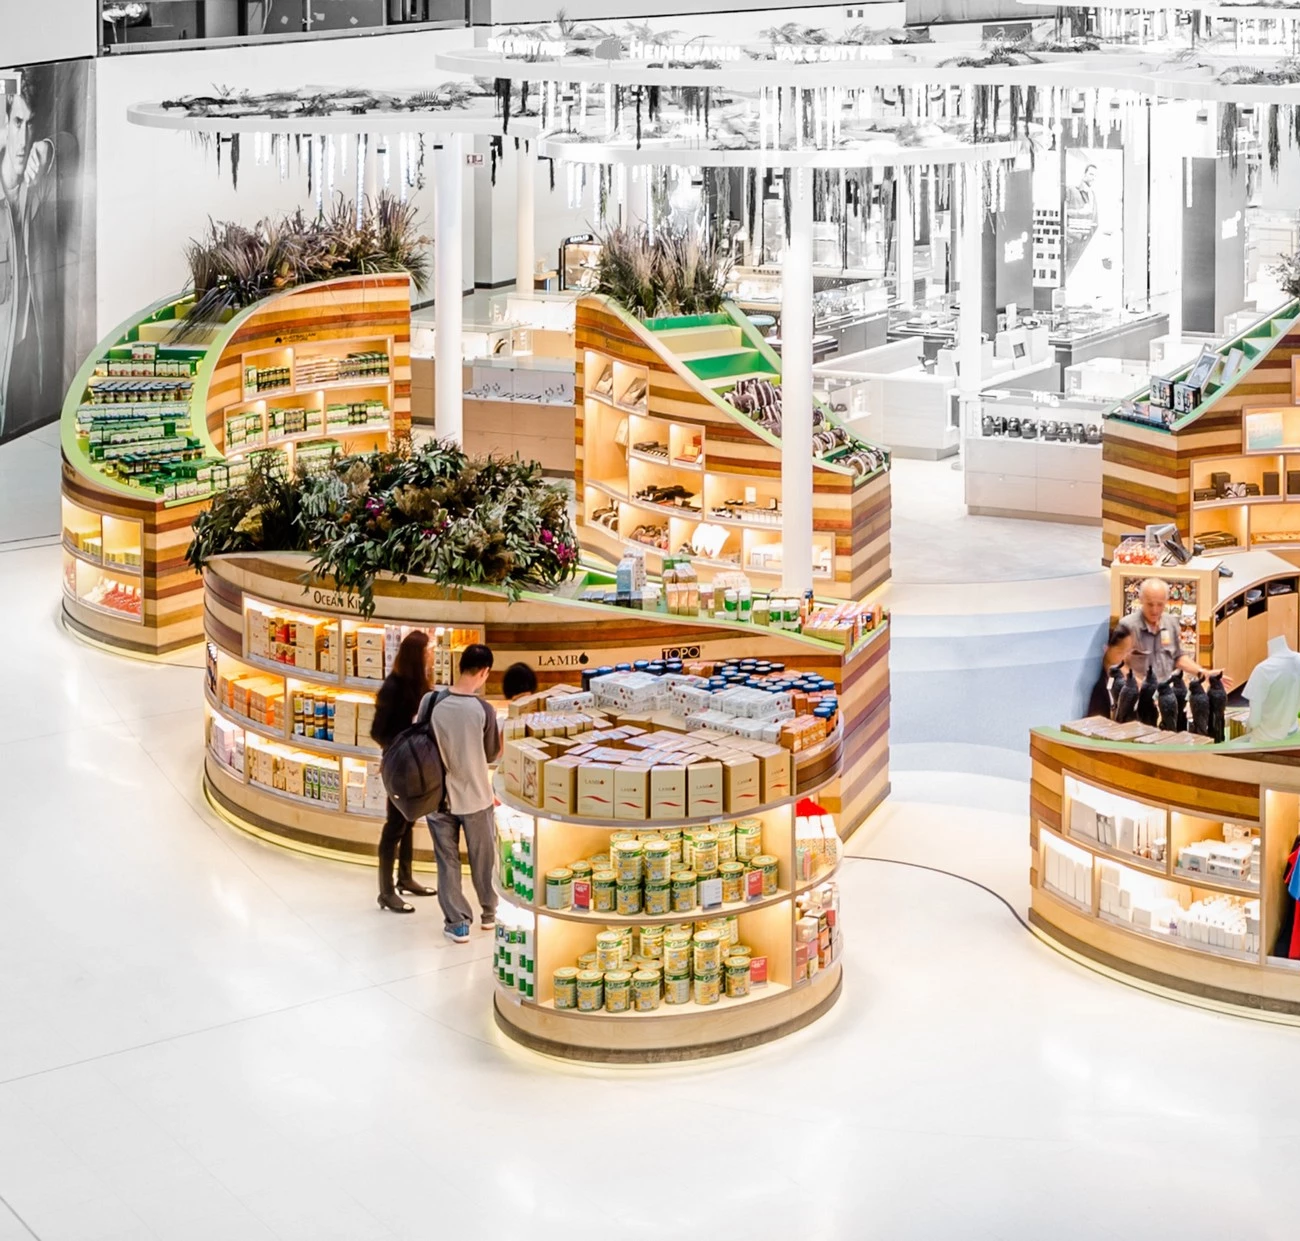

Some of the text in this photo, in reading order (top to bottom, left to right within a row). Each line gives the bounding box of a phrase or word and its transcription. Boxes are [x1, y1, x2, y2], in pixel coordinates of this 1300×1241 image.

[629, 39, 741, 61] HEINEMANN
[774, 45, 804, 61] TAX
[805, 45, 817, 61] &
[819, 45, 857, 61] DUTY
[313, 590, 344, 607] OCEAN
[662, 646, 700, 661] TOPO
